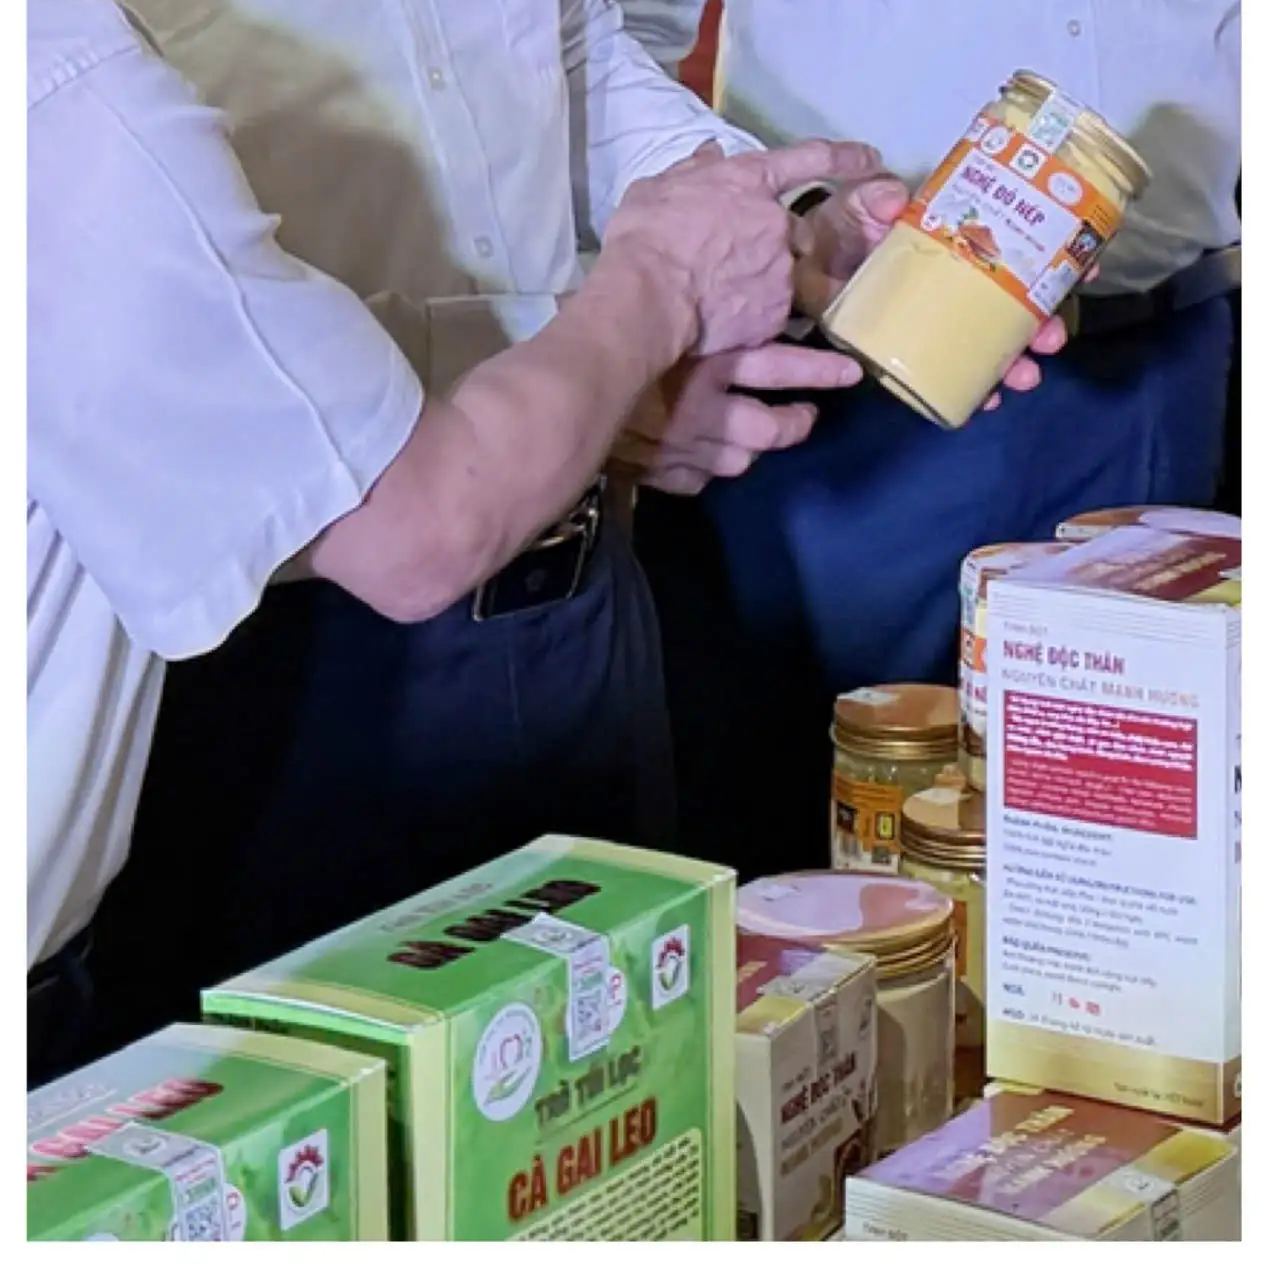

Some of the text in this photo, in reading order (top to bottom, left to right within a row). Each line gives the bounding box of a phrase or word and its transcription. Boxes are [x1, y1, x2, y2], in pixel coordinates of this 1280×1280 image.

[1003, 640, 1126, 676] NGHỆ ĐỘC THÂN
[508, 1152, 548, 1225] CÀ
[557, 1126, 603, 1198] GAI
[608, 1094, 658, 1168] LEO
